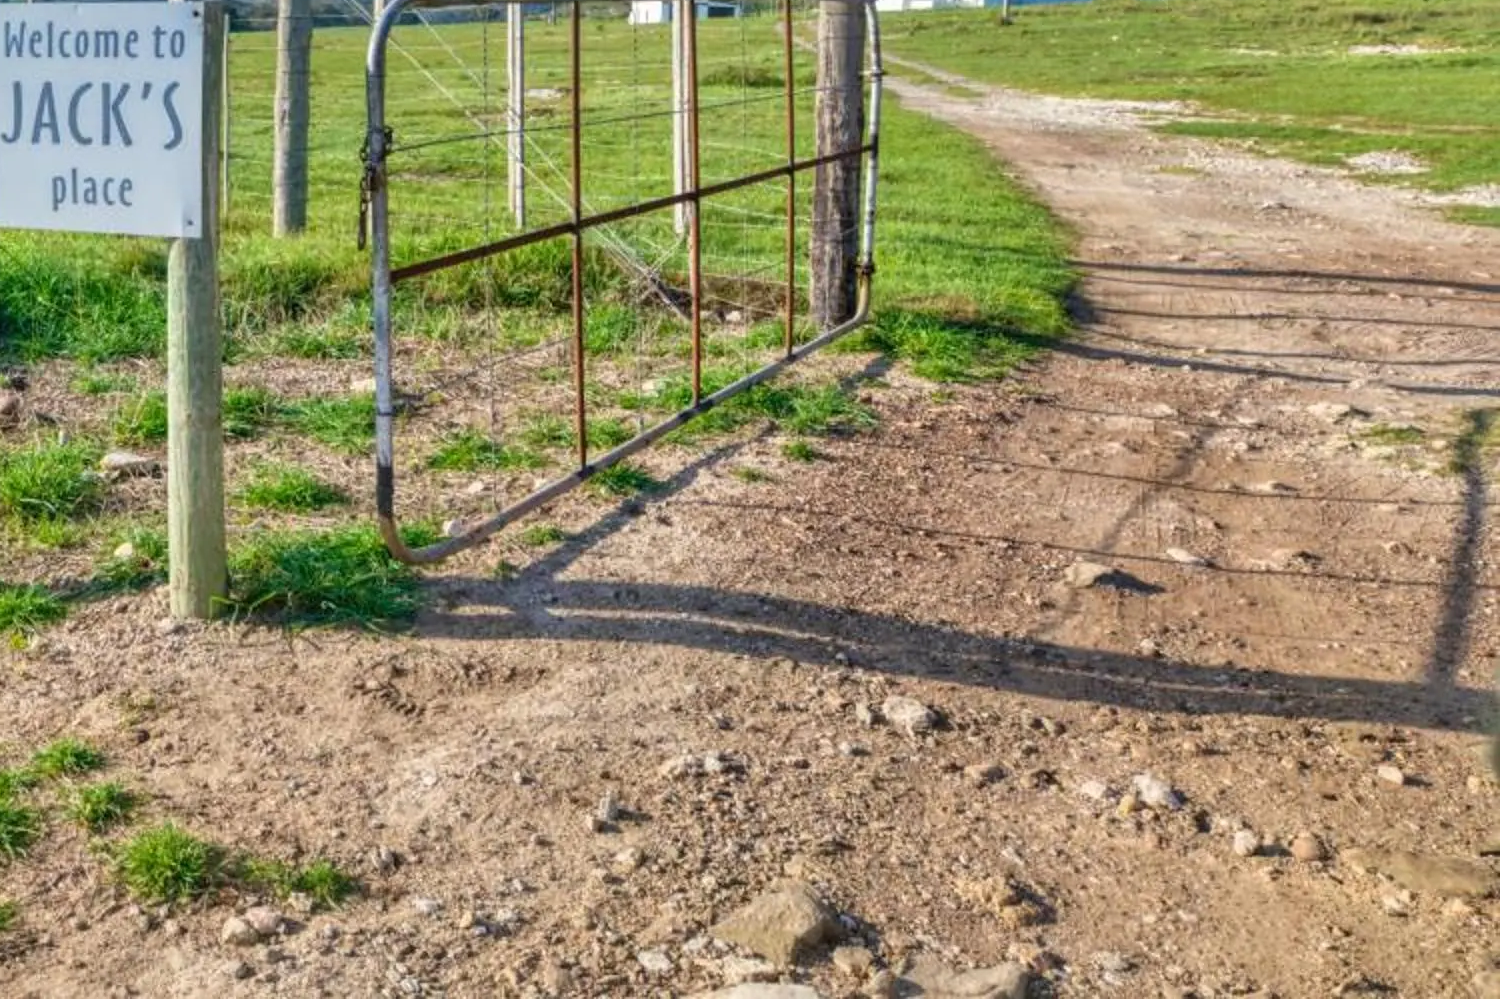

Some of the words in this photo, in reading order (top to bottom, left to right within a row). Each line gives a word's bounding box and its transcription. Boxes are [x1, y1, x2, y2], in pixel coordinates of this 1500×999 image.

[3, 21, 139, 59] Welcome
[152, 25, 186, 59] to
[0, 80, 185, 150] JACK'S
[51, 167, 133, 212] place
